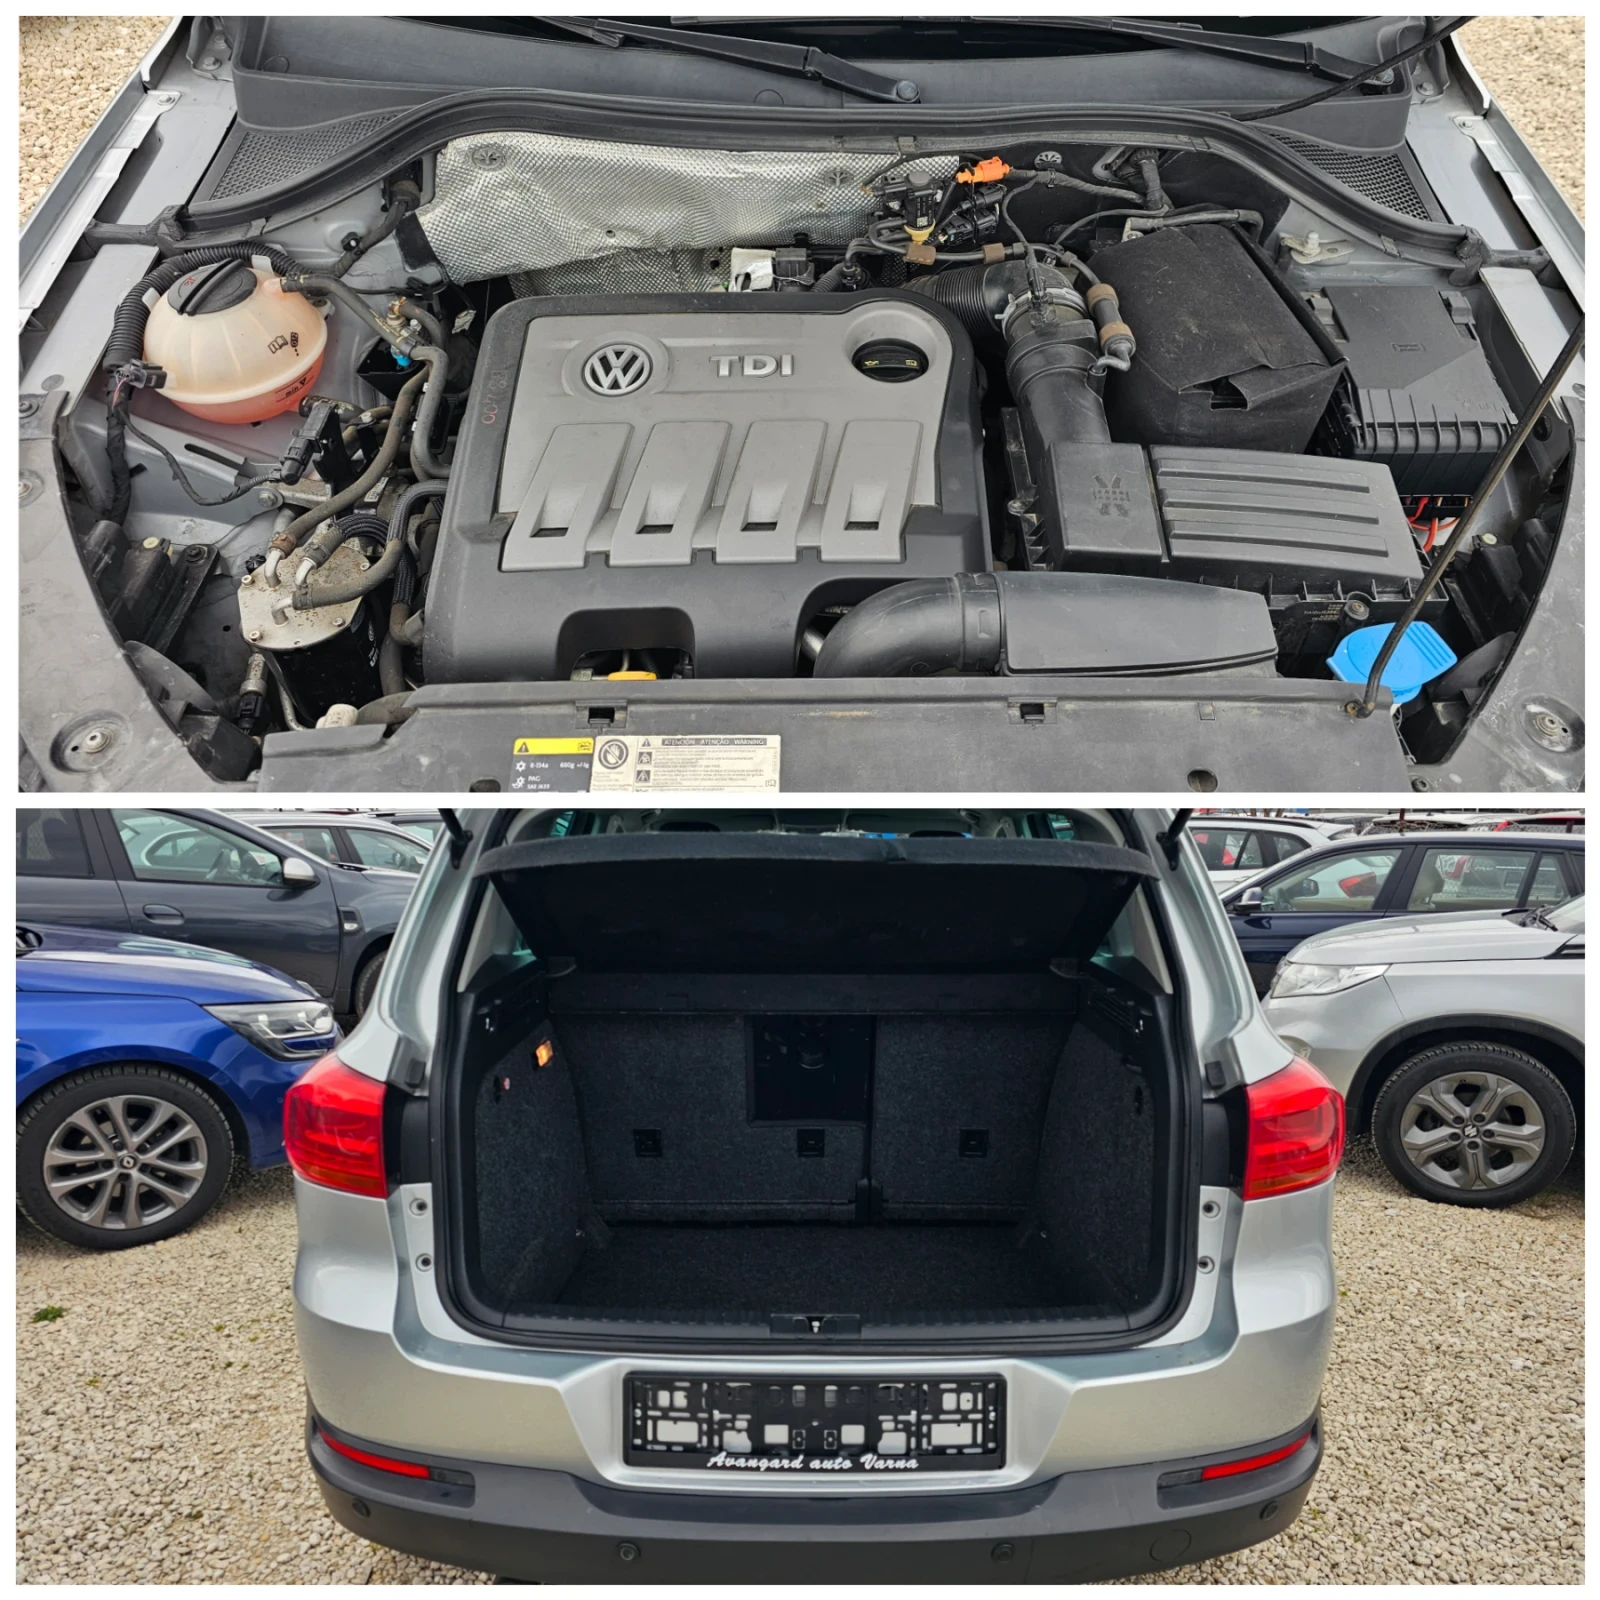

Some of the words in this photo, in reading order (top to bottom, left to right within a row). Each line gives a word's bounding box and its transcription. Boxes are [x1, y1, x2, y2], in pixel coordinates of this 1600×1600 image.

[709, 354, 793, 378] TDI
[707, 1451, 804, 1472] Avangard
[809, 1456, 853, 1470] auto
[860, 1453, 919, 1470] Varna
